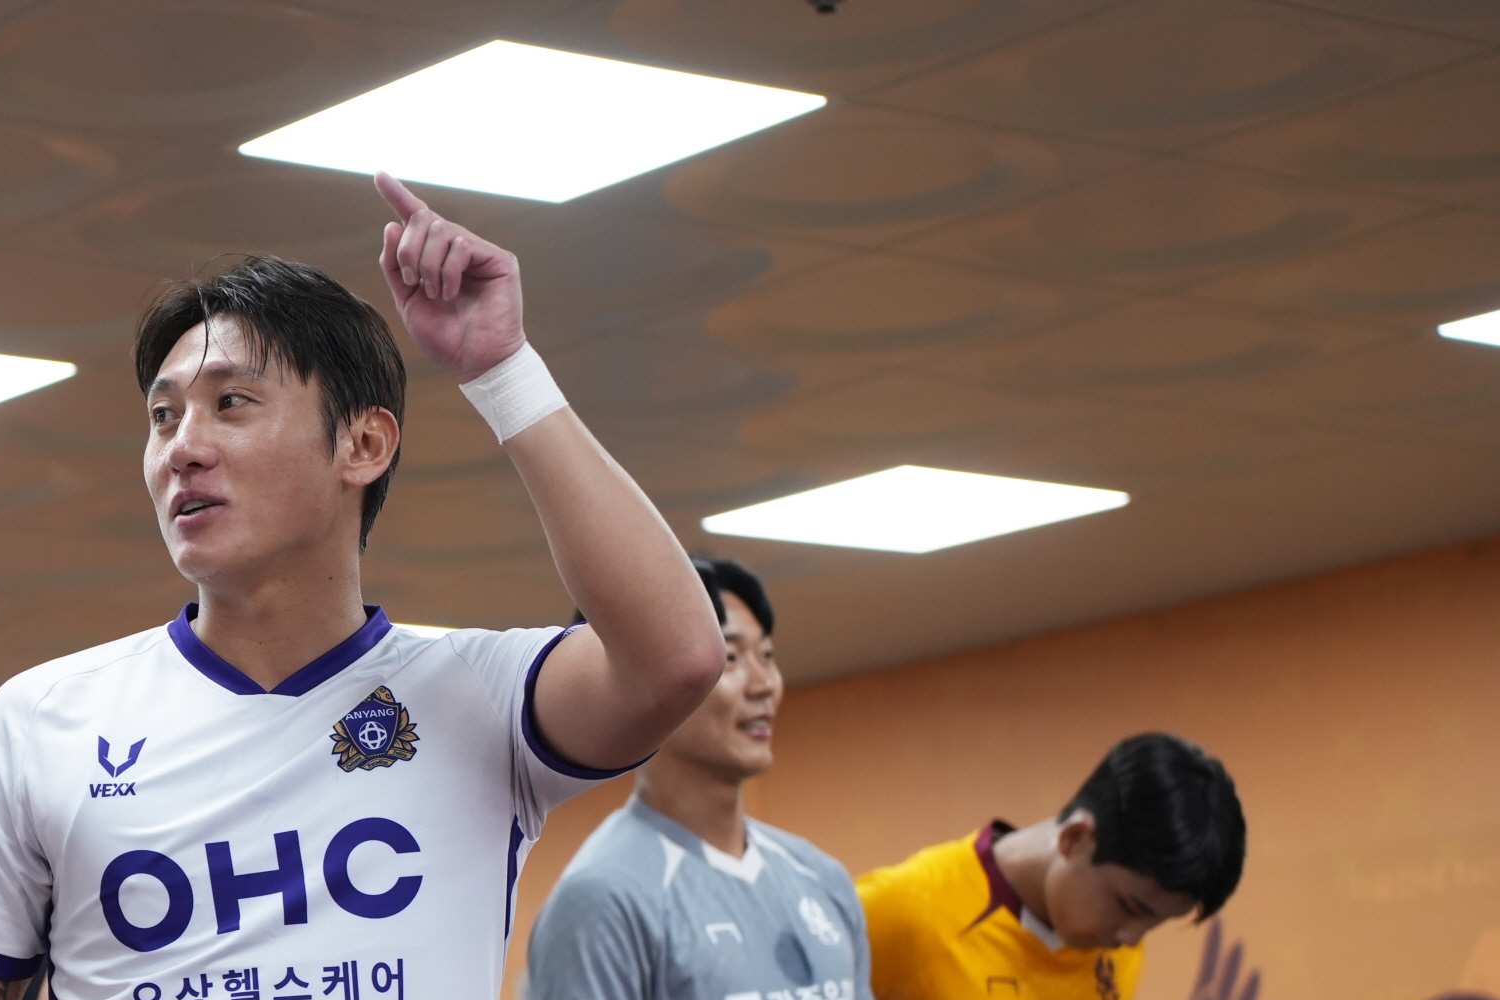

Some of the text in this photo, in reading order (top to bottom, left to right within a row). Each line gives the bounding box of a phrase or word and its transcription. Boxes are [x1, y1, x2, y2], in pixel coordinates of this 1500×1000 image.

[345, 708, 395, 721] ANYANG
[89, 782, 136, 798] VEXX
[100, 817, 424, 953] OHC
